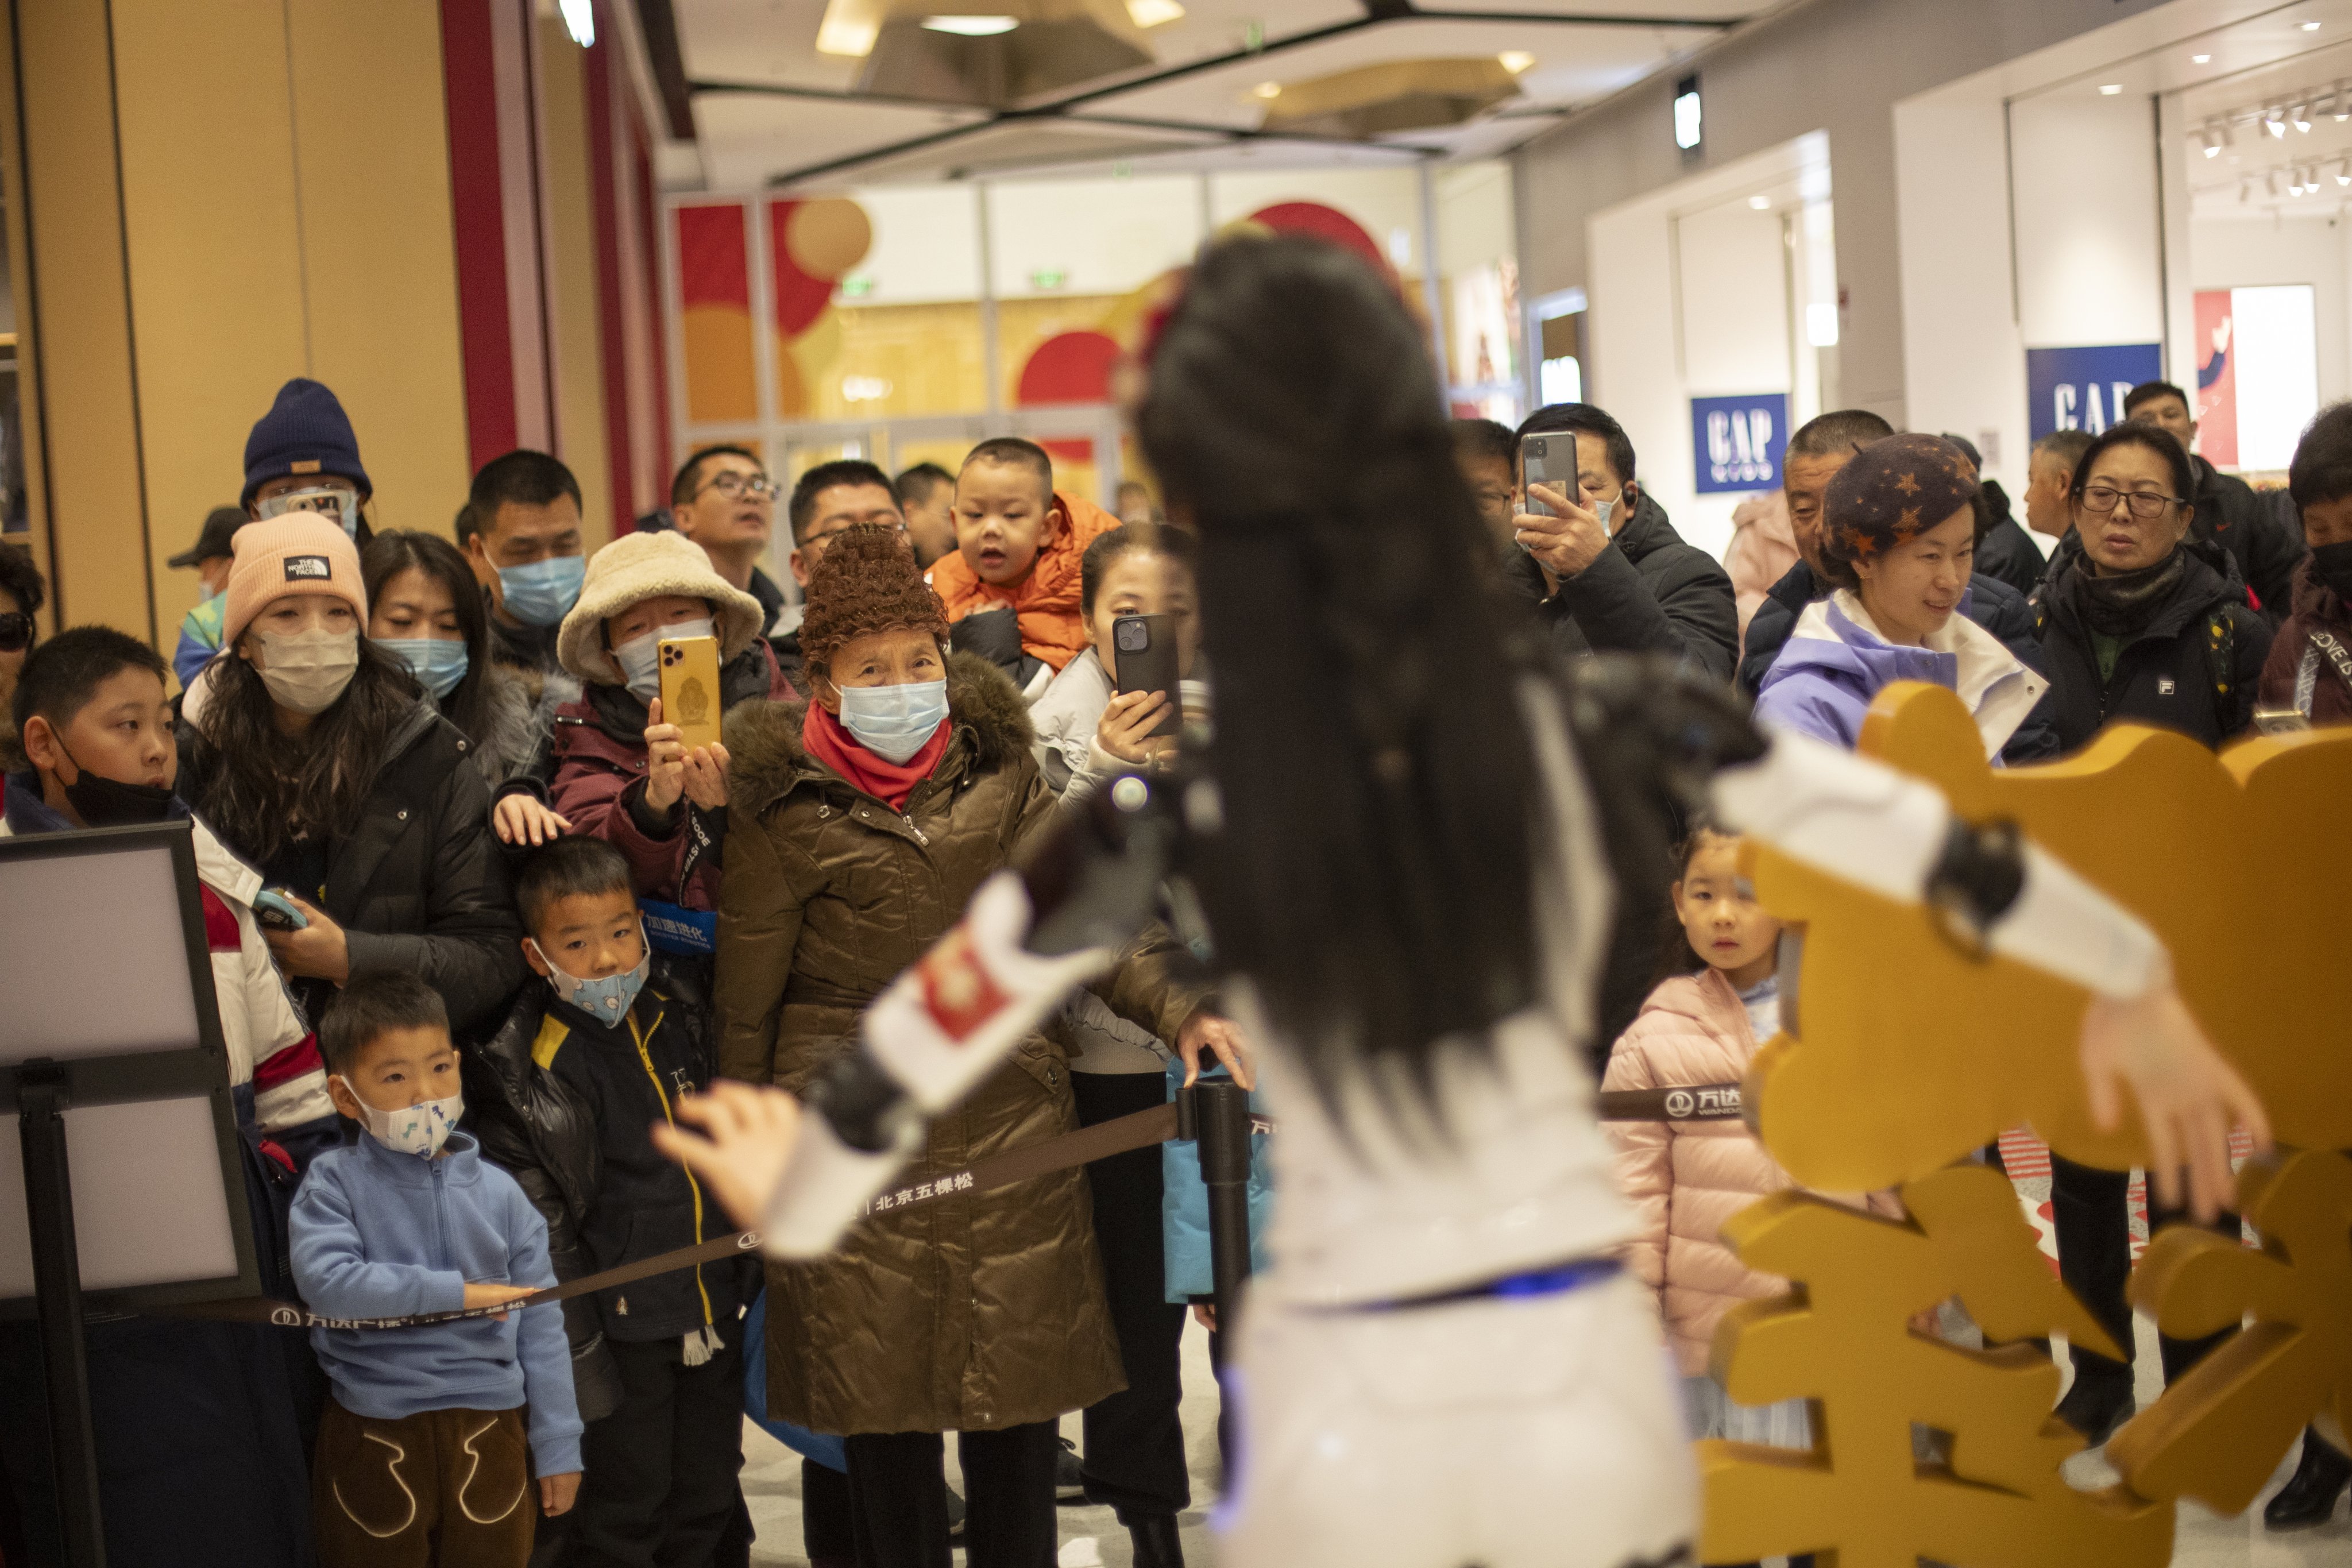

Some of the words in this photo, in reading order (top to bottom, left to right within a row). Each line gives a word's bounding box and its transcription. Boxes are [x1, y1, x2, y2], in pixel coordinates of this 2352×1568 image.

[1706, 408, 1773, 465] GAP
[288, 563, 314, 573] NORTH
[875, 1172, 974, 1211] 北京五棵松
